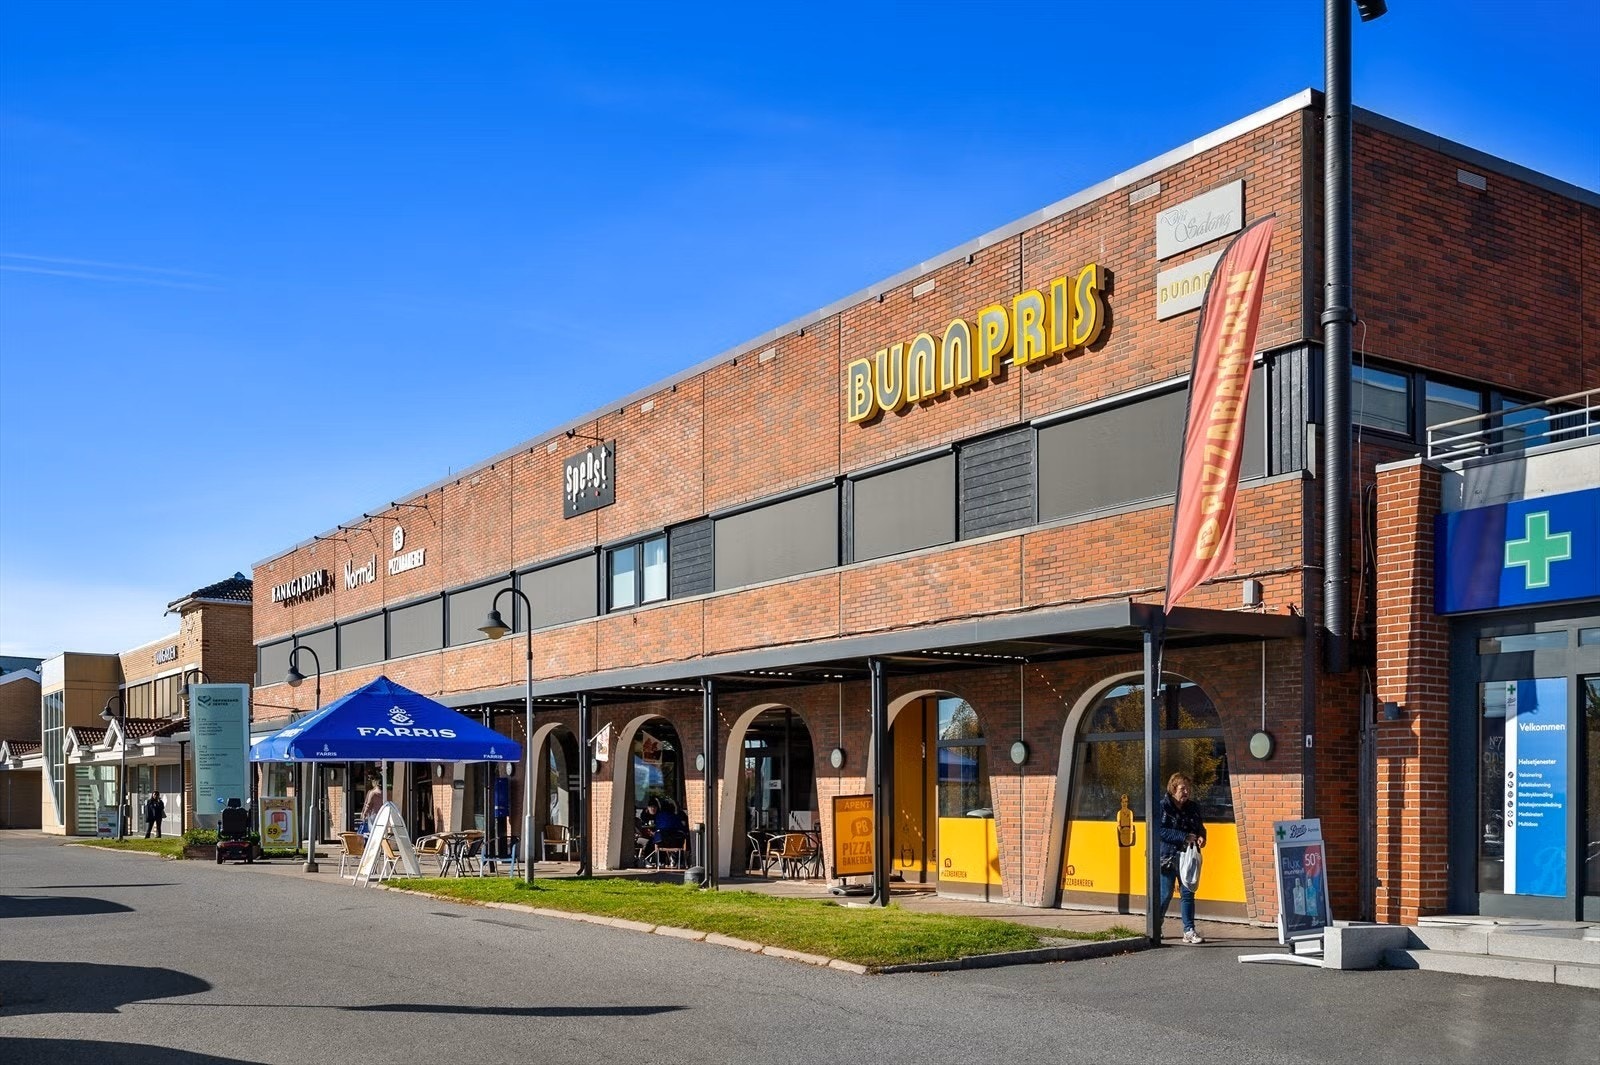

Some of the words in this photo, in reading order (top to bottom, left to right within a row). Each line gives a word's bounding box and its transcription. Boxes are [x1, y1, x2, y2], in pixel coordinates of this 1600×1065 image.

[1160, 271, 1212, 303] BUNNP
[848, 262, 1105, 423] BUNNPRIS
[566, 446, 607, 508] spenst
[344, 553, 377, 591] Normal
[356, 726, 457, 738] FARRIS
[1519, 723, 1566, 732] Velkommen
[842, 841, 872, 856] PIZZA
[842, 855, 873, 866] BAKEREN
[1304, 852, 1322, 866] 50%
